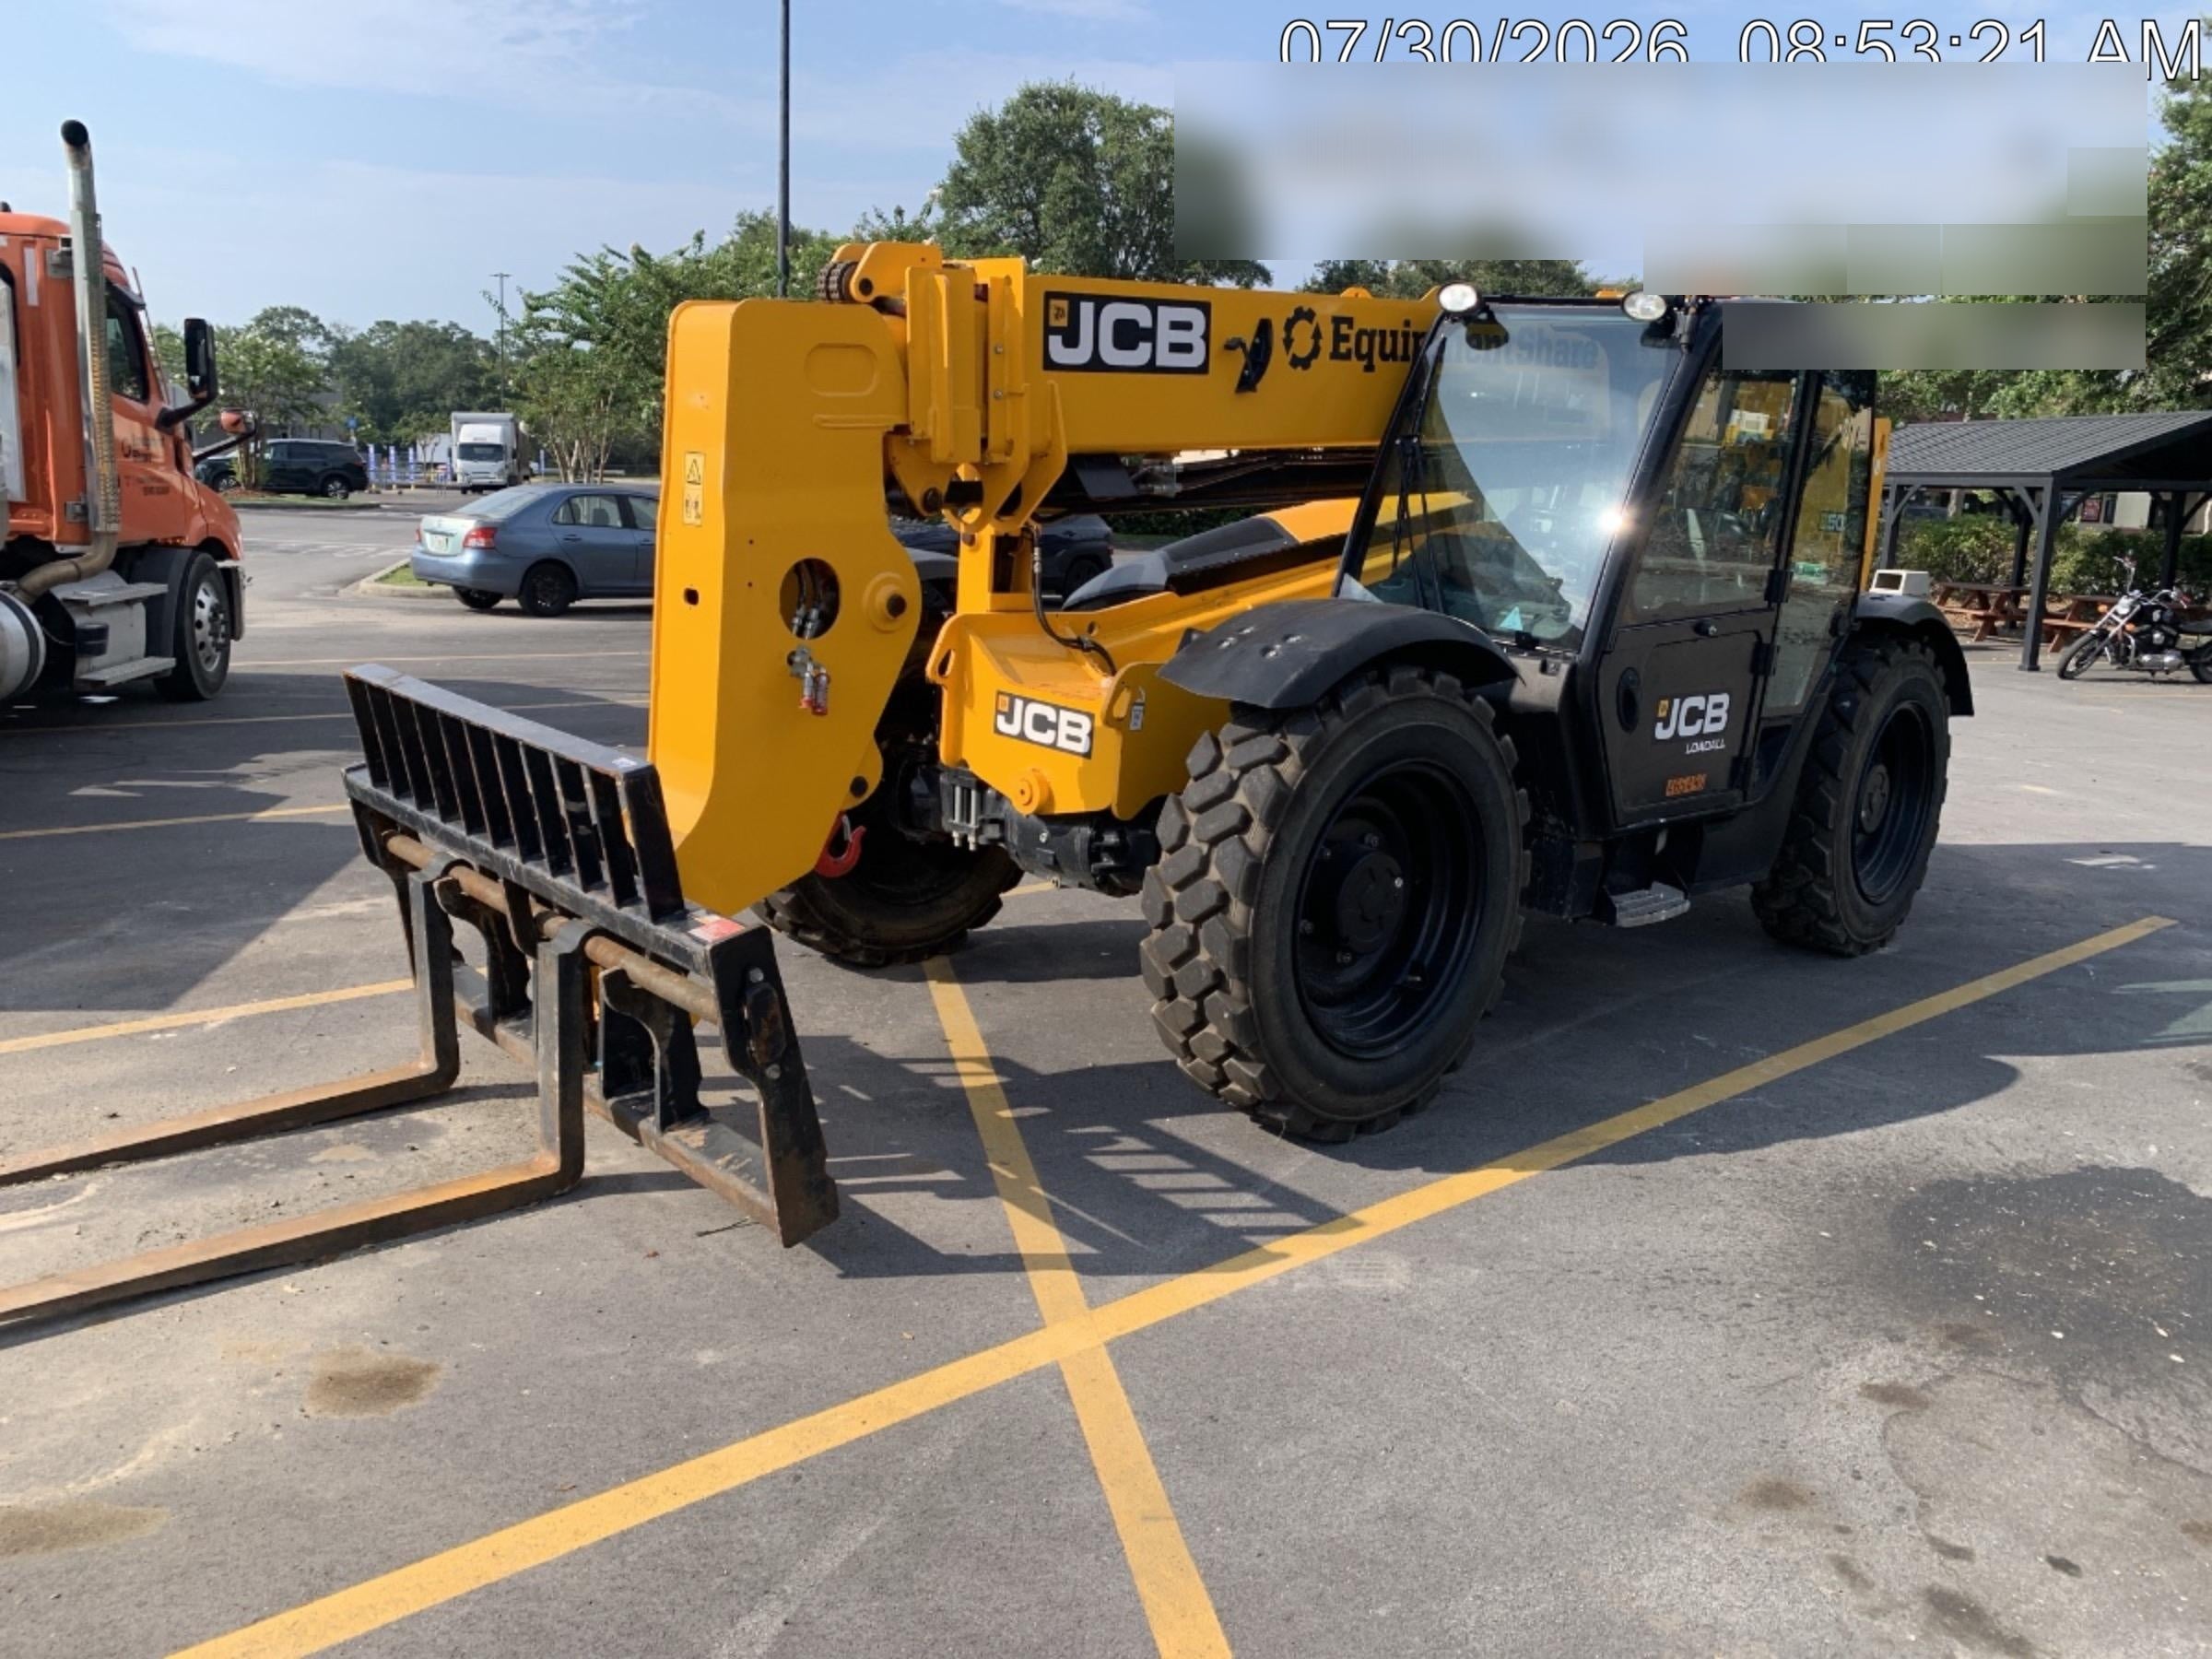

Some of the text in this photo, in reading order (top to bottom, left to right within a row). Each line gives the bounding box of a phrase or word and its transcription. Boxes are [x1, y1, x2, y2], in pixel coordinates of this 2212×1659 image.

[1048, 300, 1206, 368] JCB
[995, 697, 1092, 754] JCB
[1654, 693, 1730, 740] JCB
